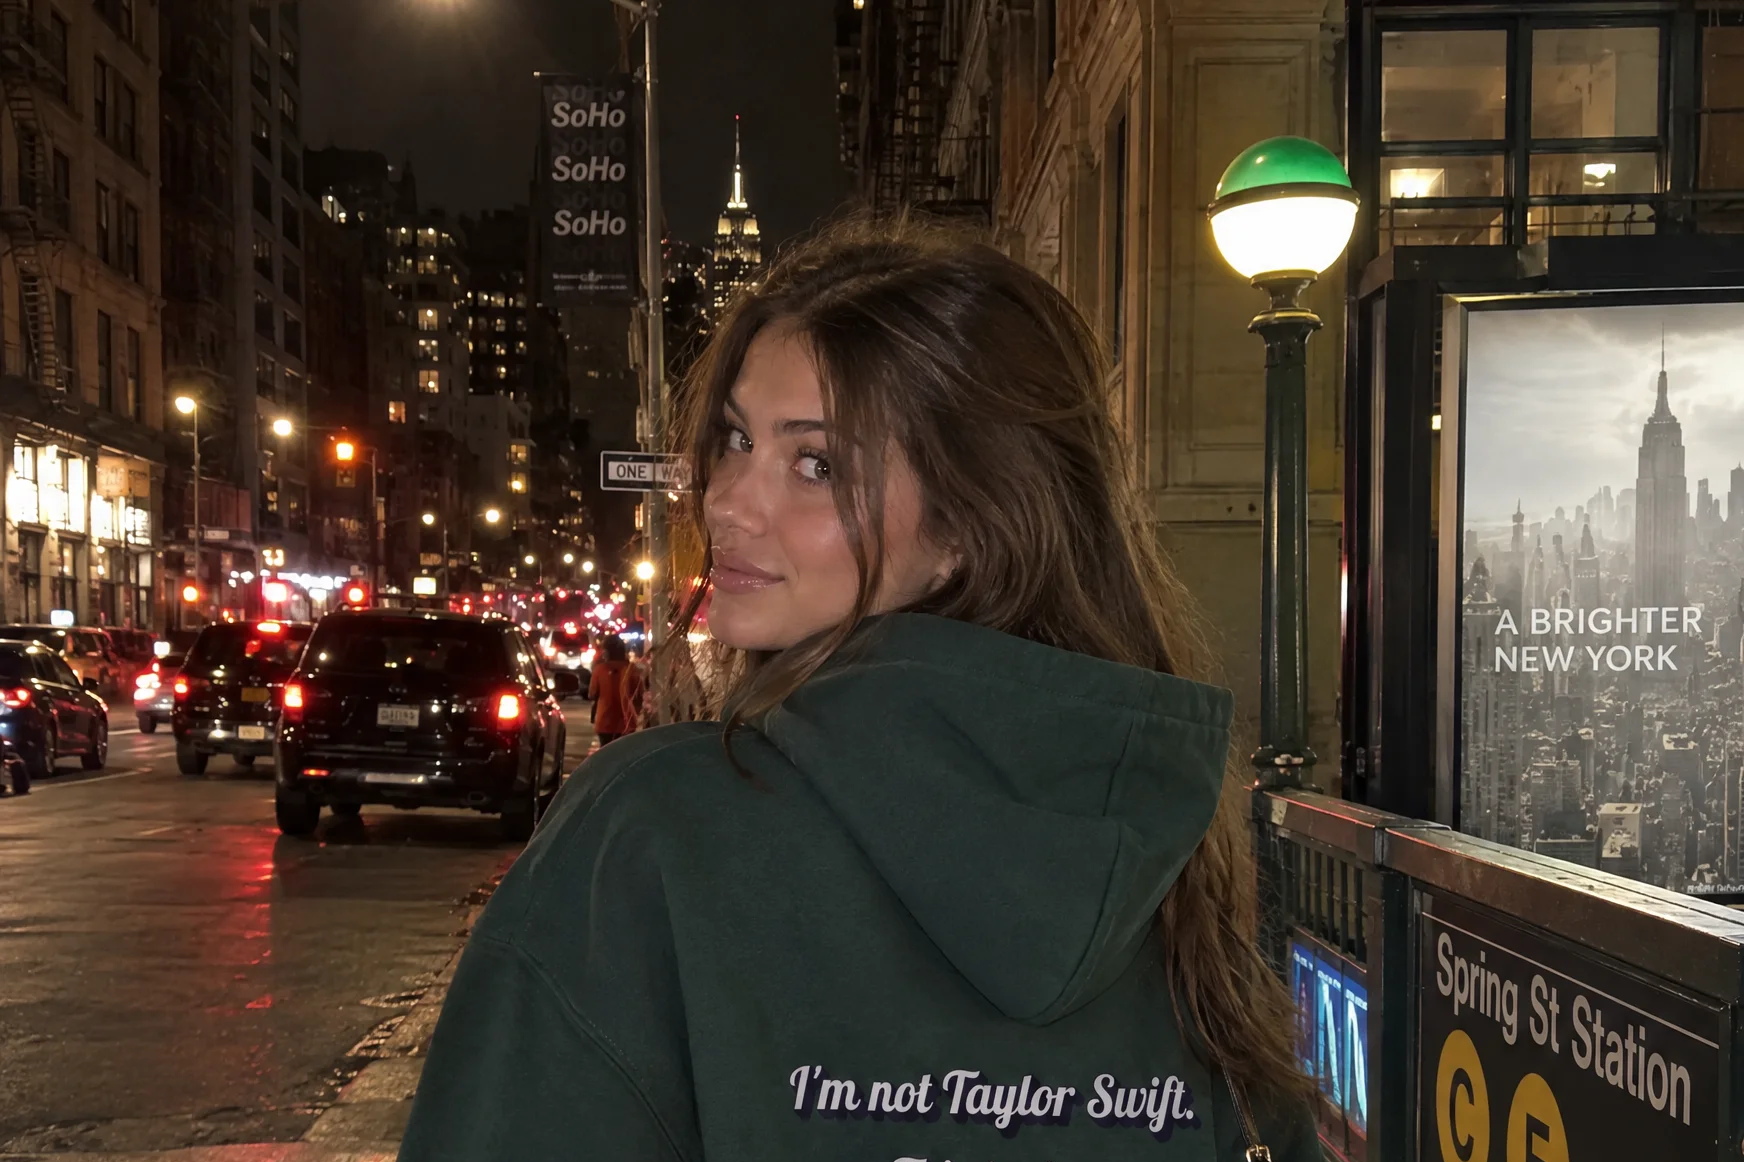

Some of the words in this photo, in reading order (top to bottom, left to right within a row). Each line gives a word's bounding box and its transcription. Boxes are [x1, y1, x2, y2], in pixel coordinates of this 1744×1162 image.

[551, 101, 626, 128] SoHo
[552, 155, 626, 182] SoHo
[552, 209, 627, 236] SoHo
[616, 464, 647, 479] ONE
[1494, 608, 1519, 635] A
[1531, 606, 1702, 635] BRIGHTER
[1495, 646, 1575, 673] NEW
[1585, 644, 1678, 671] YORK
[1436, 932, 1518, 1045] Spring
[1529, 974, 1560, 1054] St
[1572, 995, 1691, 1126] Station
[789, 1065, 861, 1111] I'm
[867, 1074, 934, 1114] not
[942, 1069, 1076, 1129] Taylor
[1086, 1073, 1195, 1133] Swift.
[1449, 1067, 1475, 1162] C
